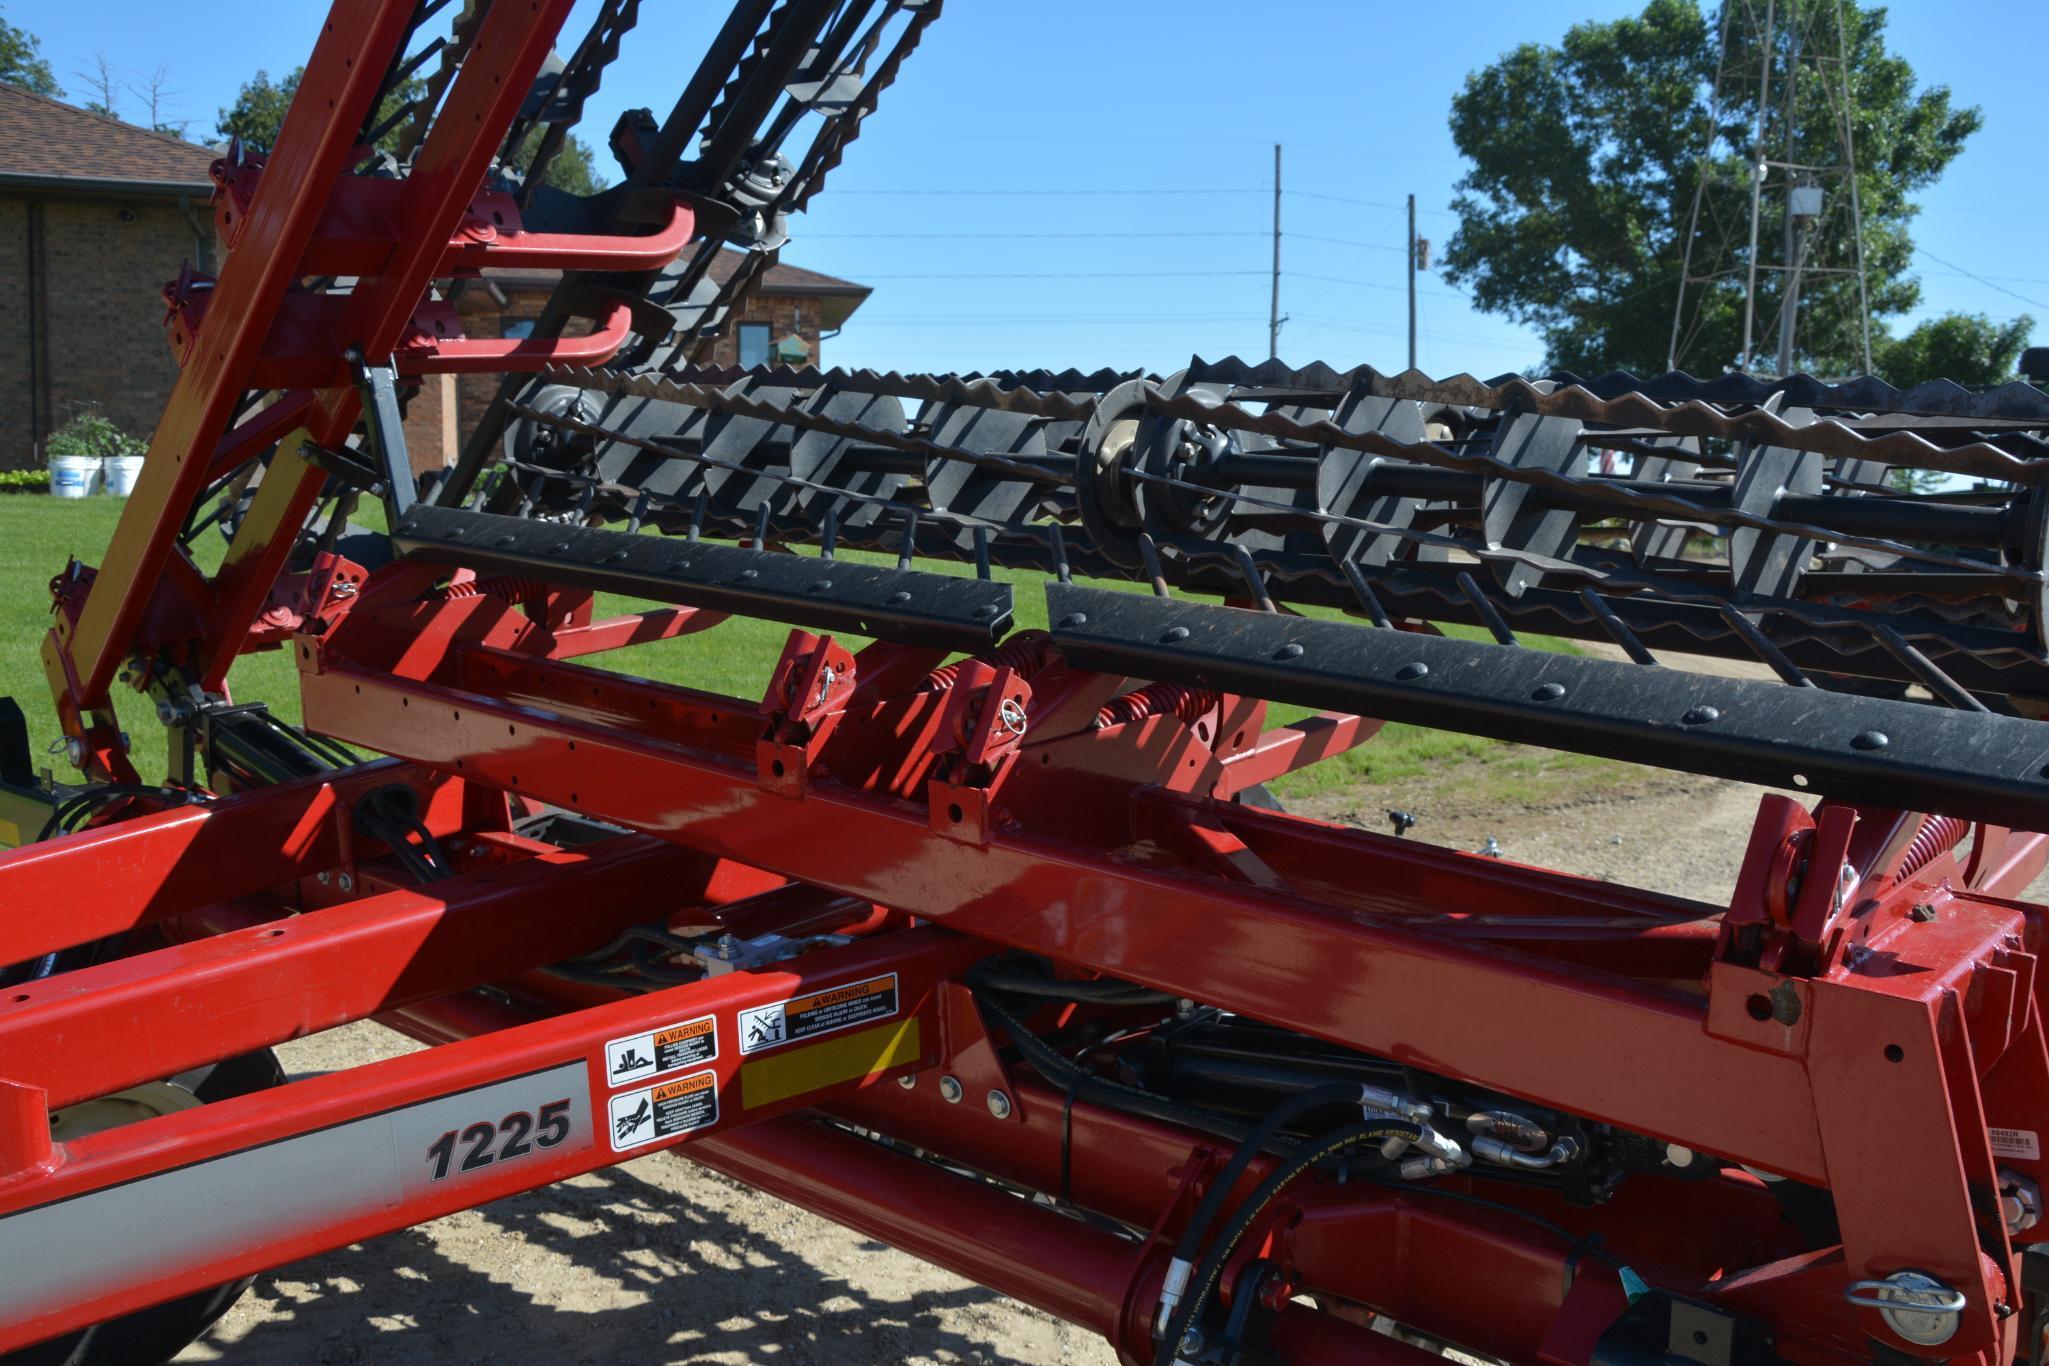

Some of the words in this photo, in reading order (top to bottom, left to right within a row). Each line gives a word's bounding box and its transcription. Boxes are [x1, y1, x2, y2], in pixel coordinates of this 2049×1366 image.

[822, 985, 870, 1004] WARNING
[669, 1022, 711, 1040] WARNING
[668, 1076, 711, 1094] WARNING
[426, 1098, 571, 1182] 1225
